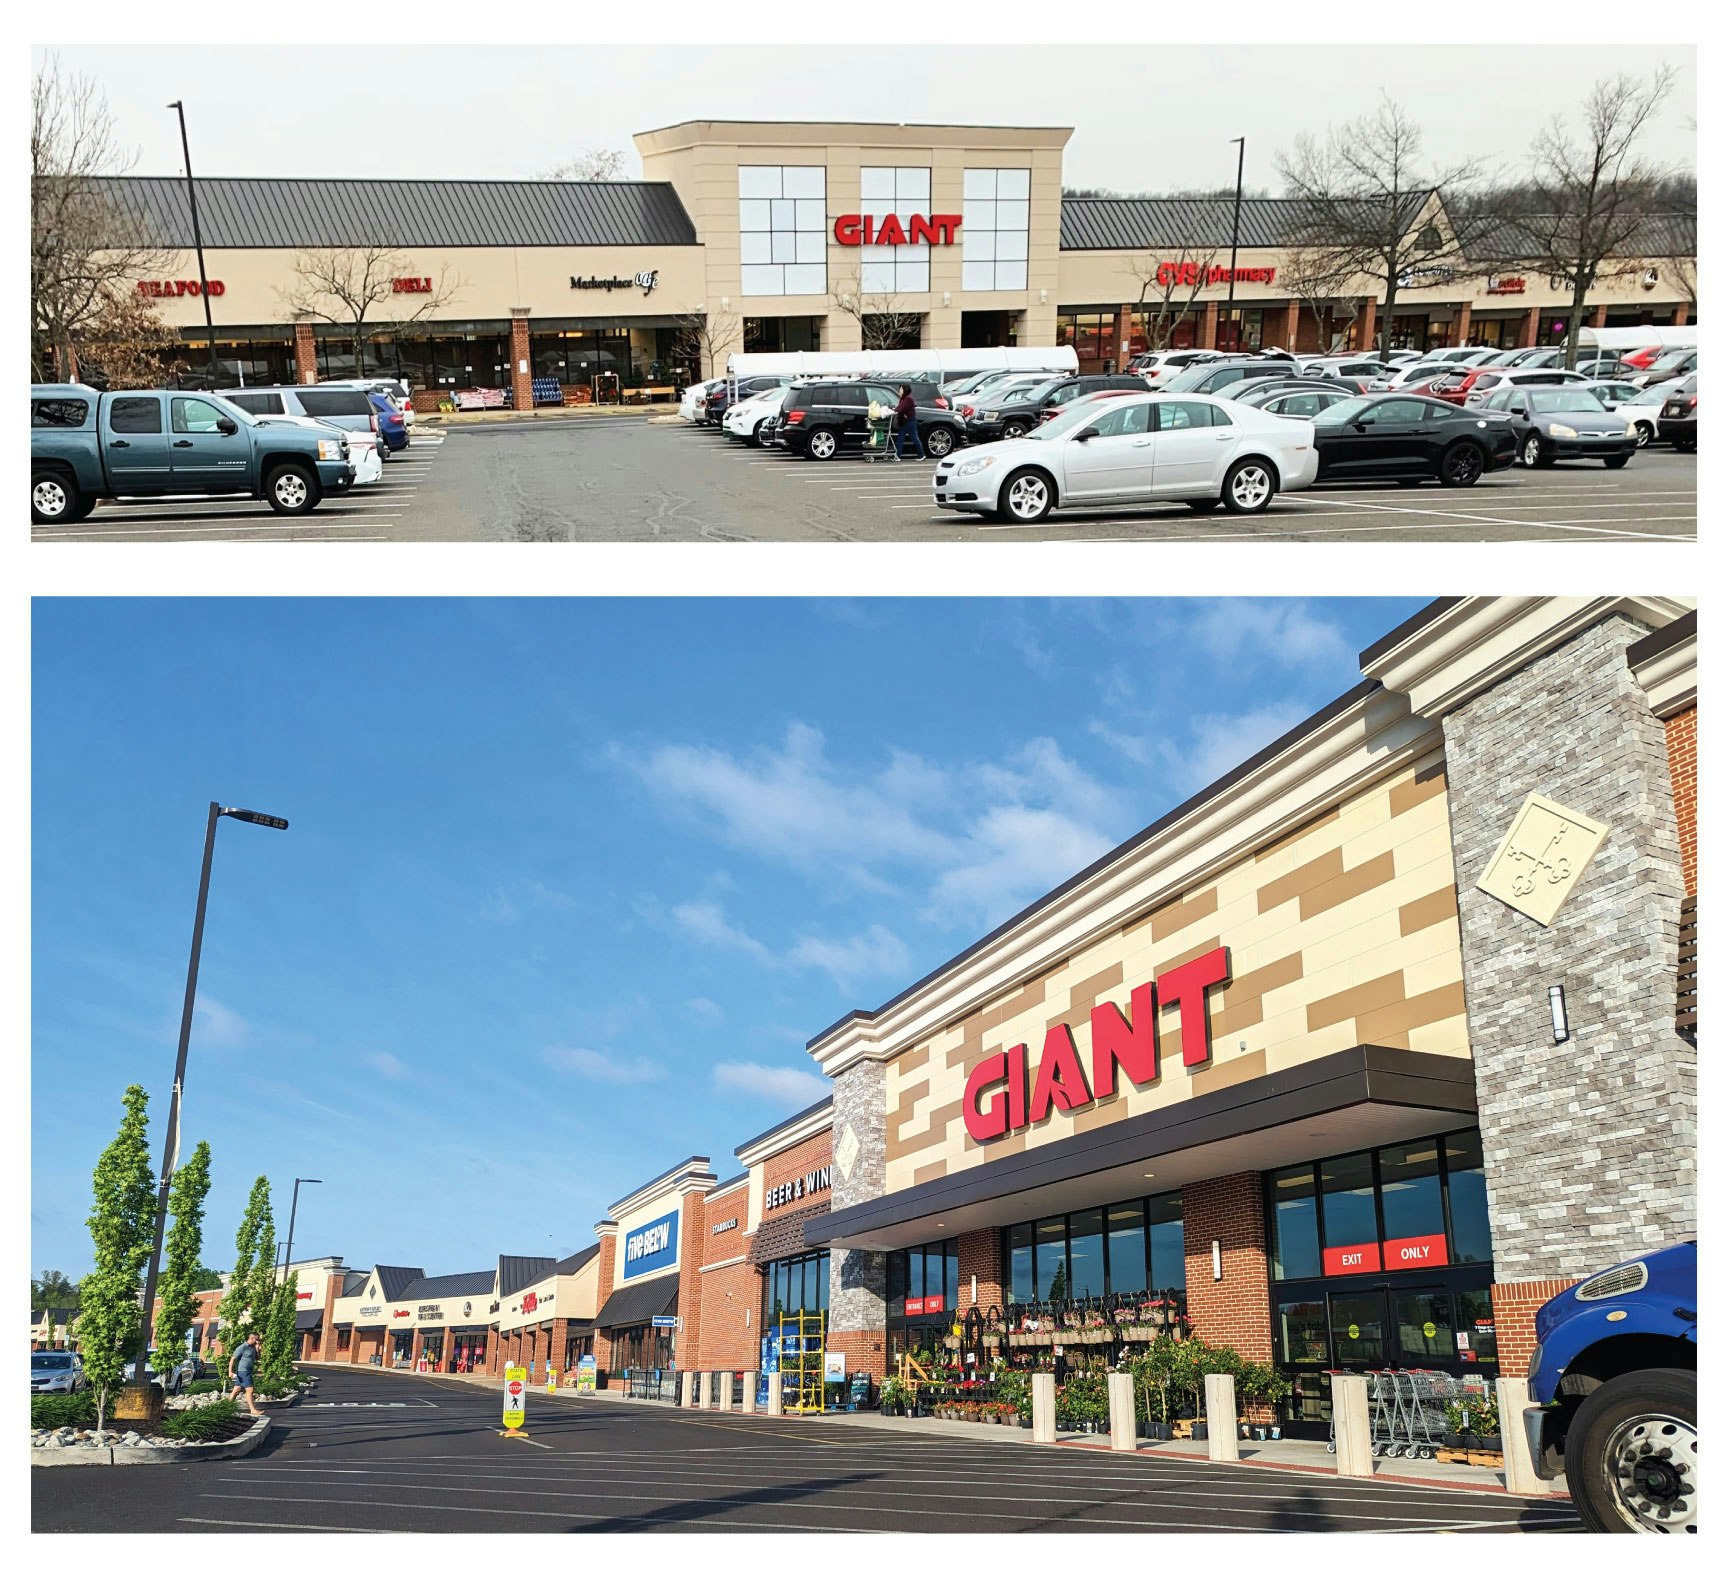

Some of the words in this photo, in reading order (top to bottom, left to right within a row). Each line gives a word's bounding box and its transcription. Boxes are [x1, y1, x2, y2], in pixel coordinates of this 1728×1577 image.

[834, 213, 962, 246] GIANT
[391, 277, 433, 293] DELI
[570, 275, 633, 292] Marketplace
[962, 945, 1232, 1141] GIANT
[766, 1181, 793, 1210] BEER
[795, 1177, 804, 1199] &
[712, 1218, 738, 1235] STARBUCKS
[1342, 1253, 1362, 1266] EXIT
[1401, 1246, 1430, 1260] ONLY
